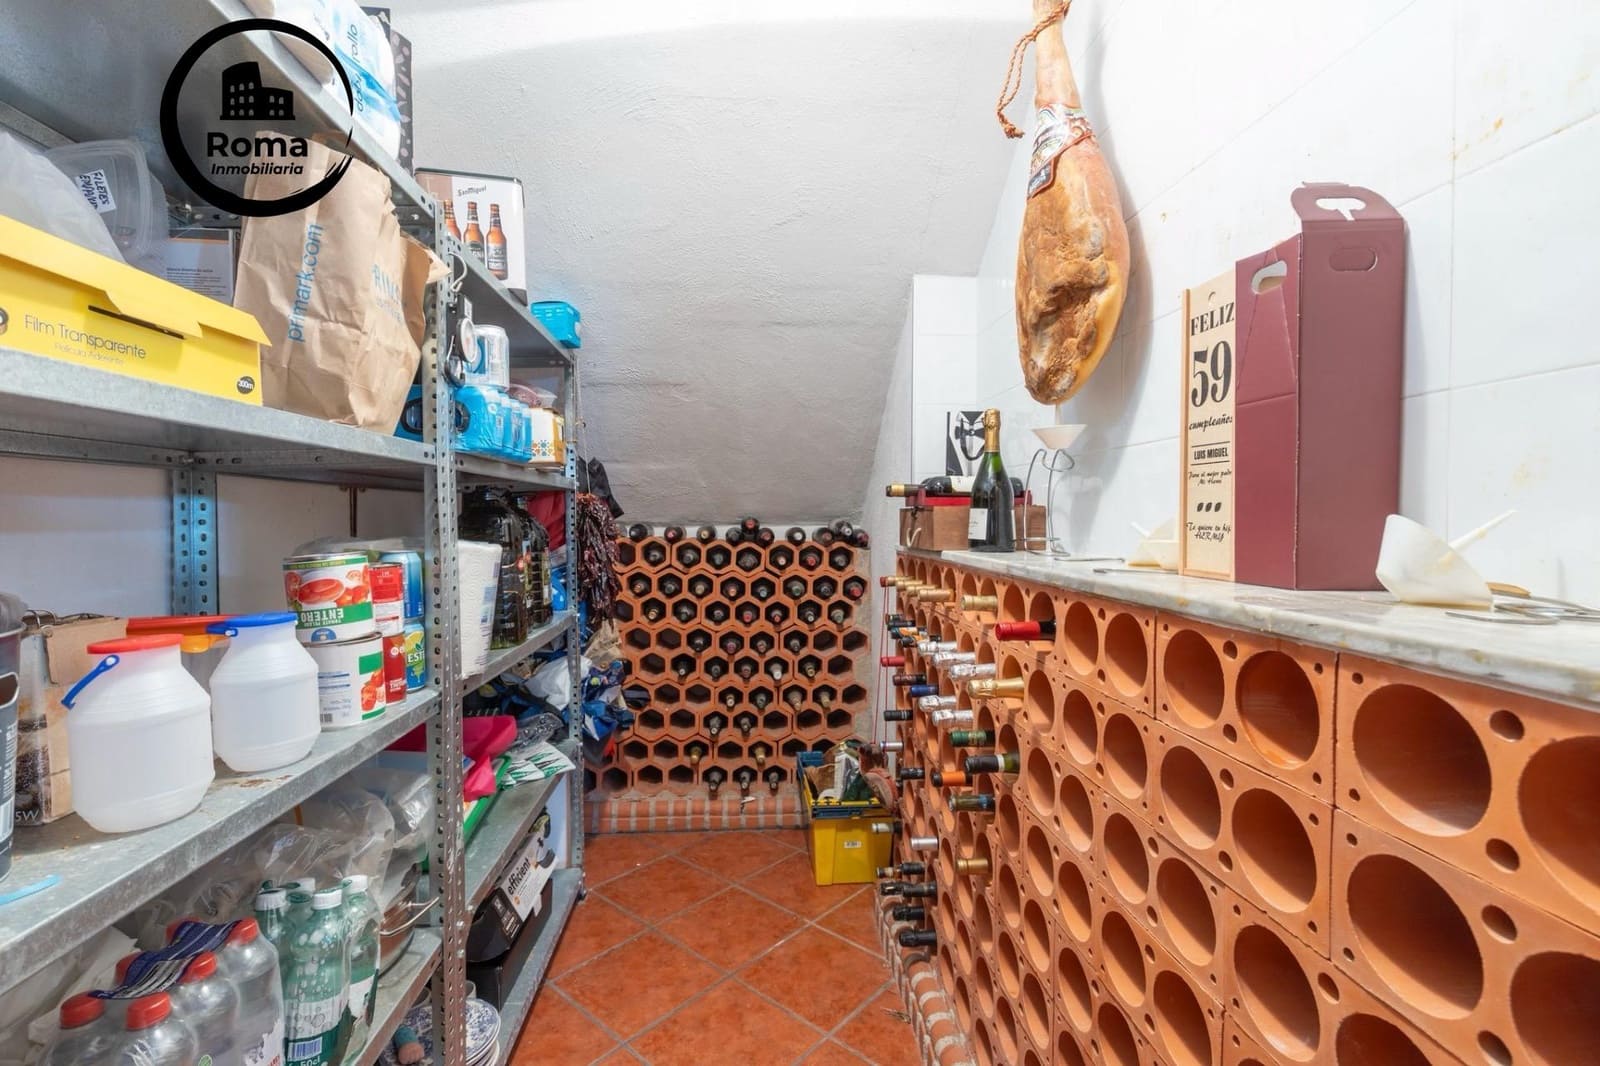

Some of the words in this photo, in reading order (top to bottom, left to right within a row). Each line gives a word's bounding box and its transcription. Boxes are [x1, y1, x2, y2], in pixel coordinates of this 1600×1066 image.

[93, 171, 111, 206] FILETES
[288, 224, 324, 342] primark.com
[25, 314, 55, 336] Film
[58, 323, 147, 359] Transparente
[1191, 302, 1235, 336] FELIZ
[1191, 340, 1232, 408] 59
[1194, 449, 1206, 461] LUIS
[1207, 447, 1229, 459] MIGUEL
[301, 608, 344, 622] ENTERO
[507, 857, 532, 896] efficient
